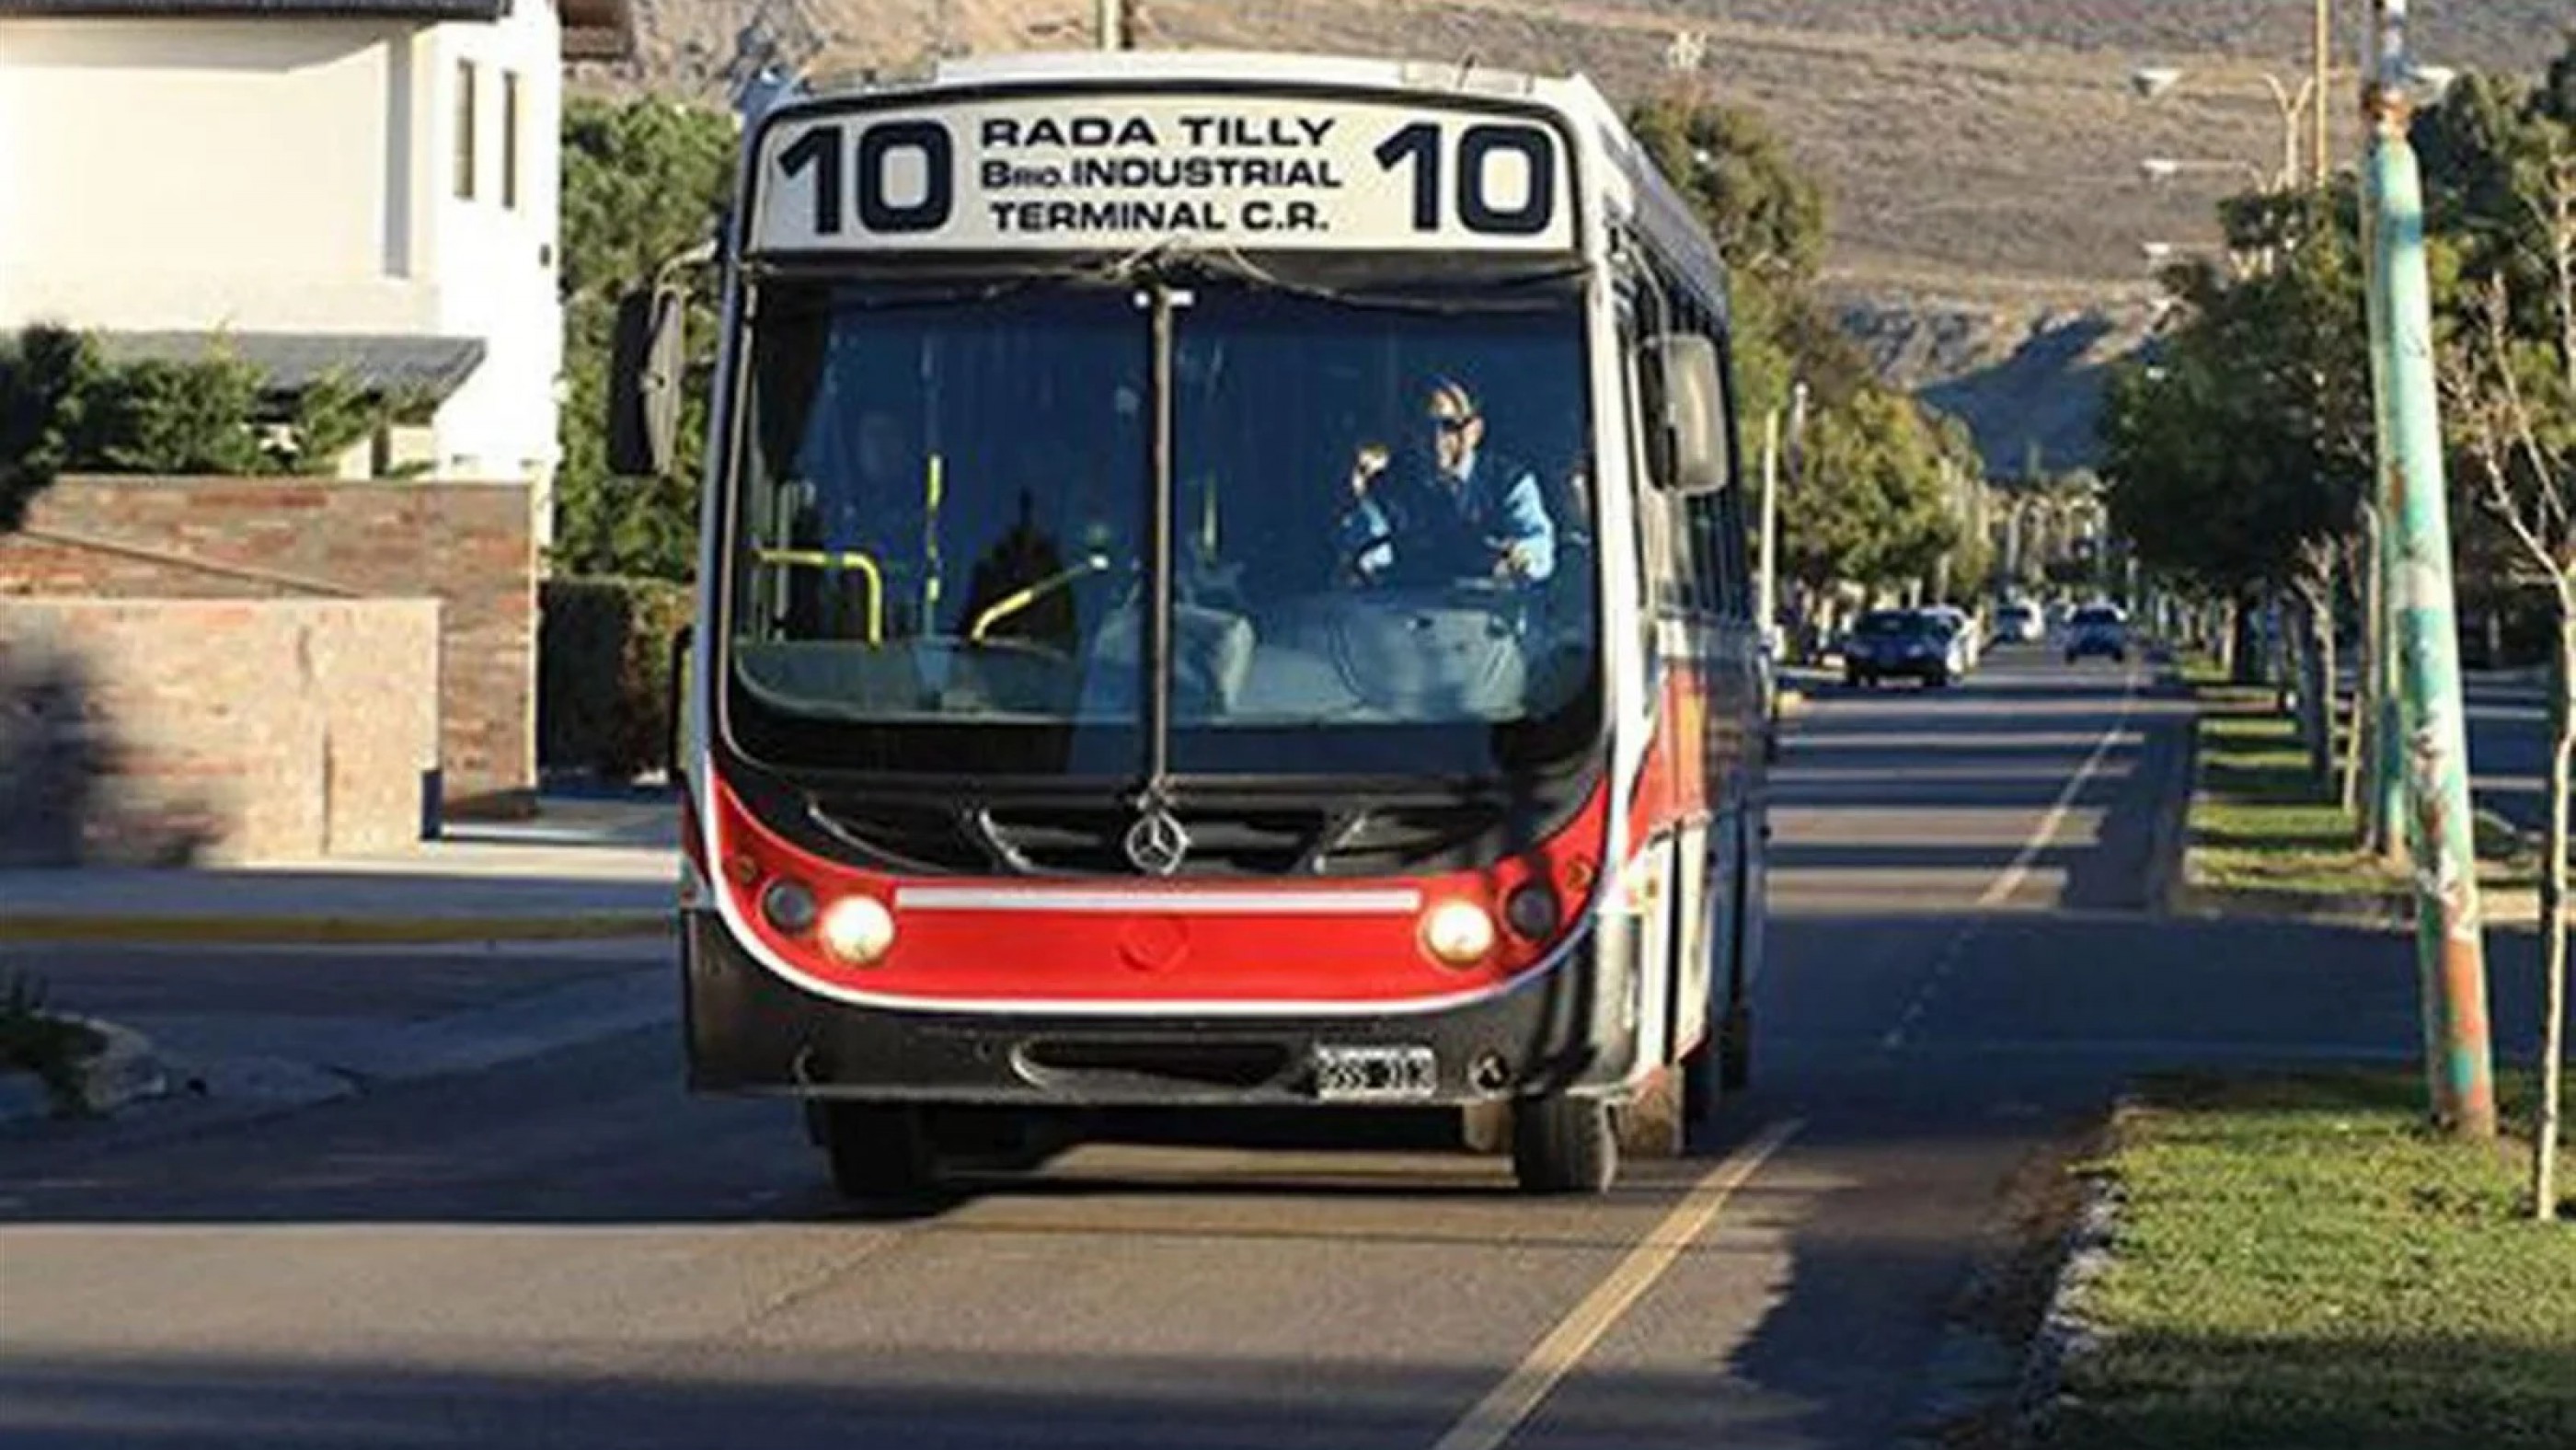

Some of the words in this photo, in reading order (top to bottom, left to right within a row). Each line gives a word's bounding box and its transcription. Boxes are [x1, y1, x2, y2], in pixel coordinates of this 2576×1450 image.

[981, 117, 1157, 148] RADA
[1179, 117, 1334, 146] TILLY
[776, 121, 954, 236] 10
[1072, 157, 1341, 188] INDUSTRIAL
[1374, 122, 1555, 236] 10
[990, 201, 1226, 232] TERMINAL
[1242, 201, 1329, 230] C.R.
